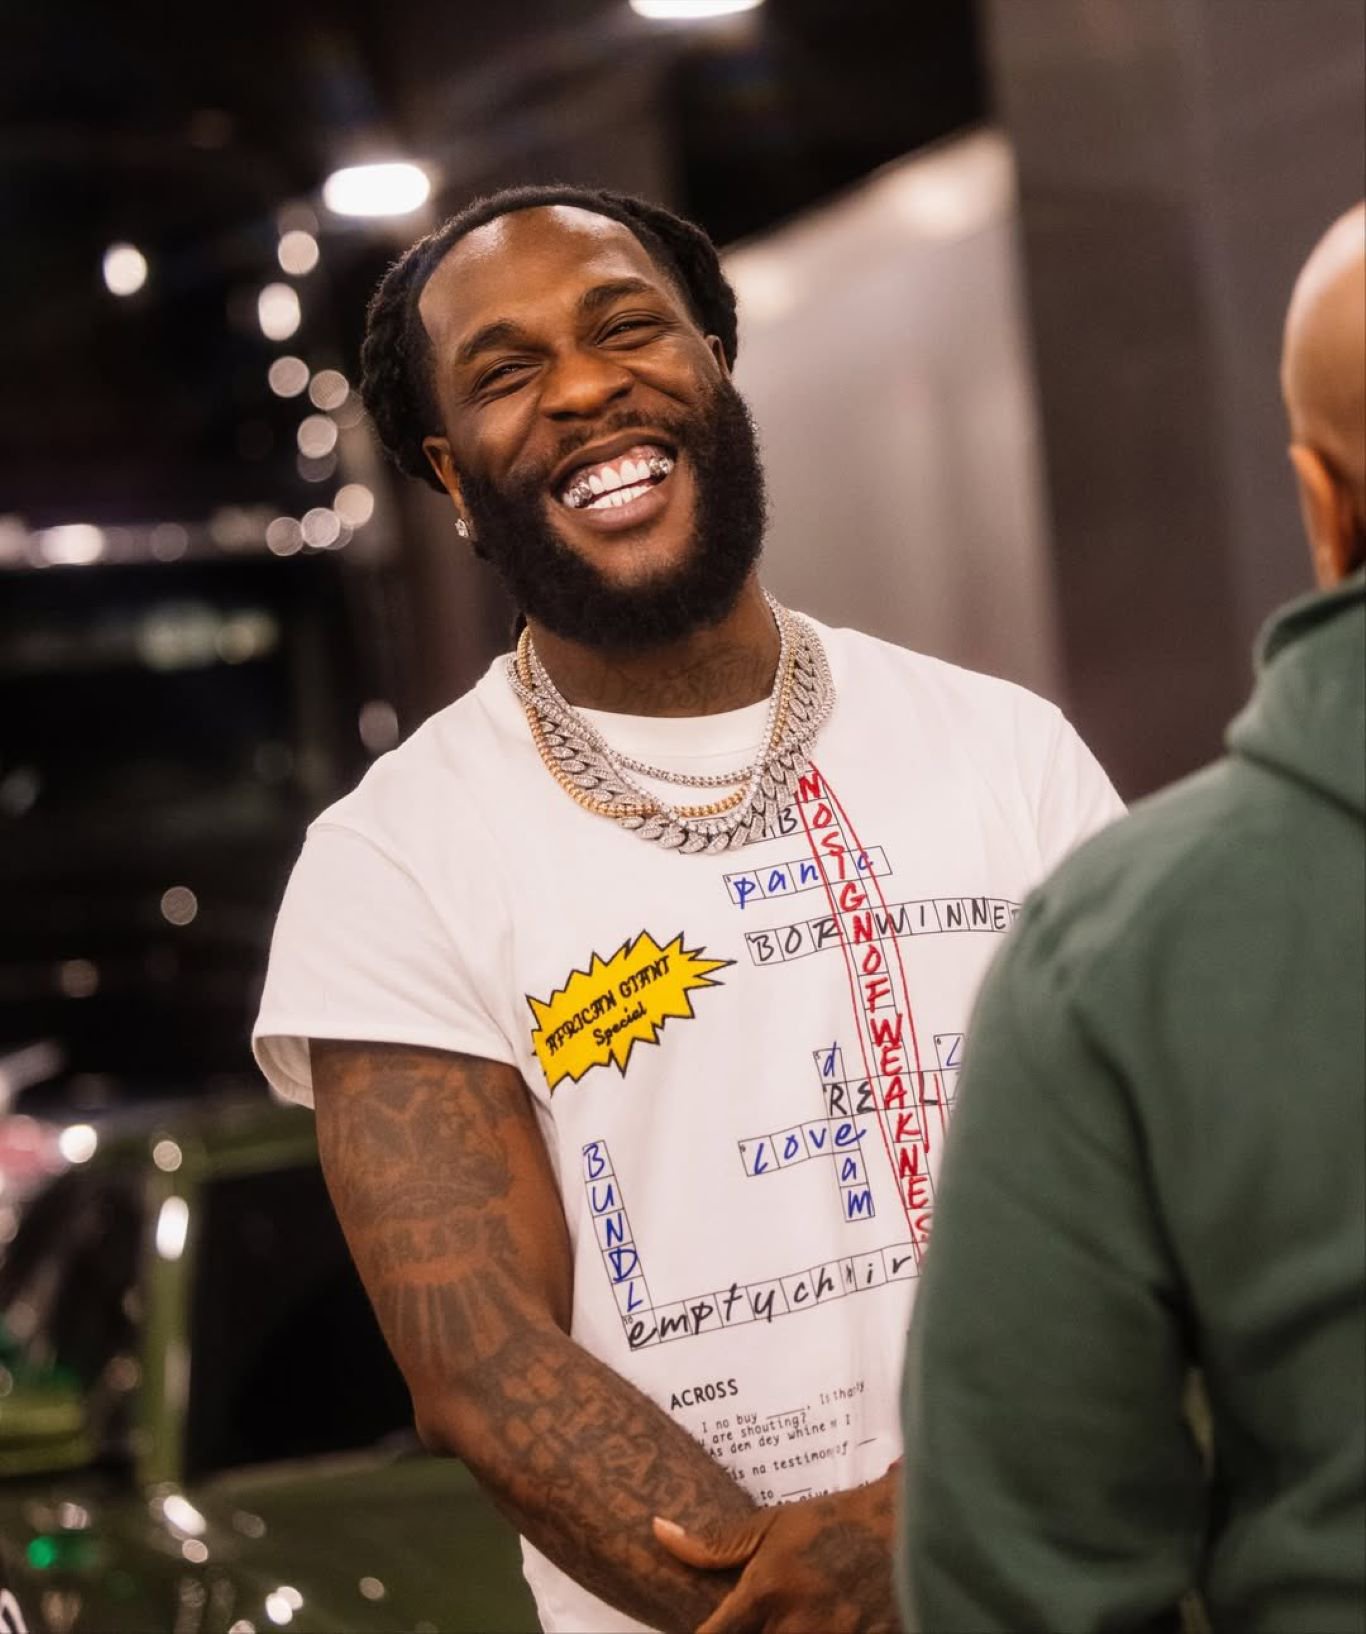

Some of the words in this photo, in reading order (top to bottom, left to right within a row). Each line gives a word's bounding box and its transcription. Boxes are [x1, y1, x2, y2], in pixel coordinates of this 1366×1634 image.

[545, 990, 617, 1056] AFRICAN
[618, 955, 669, 1000] GIANT
[592, 1001, 647, 1046] Special
[670, 1378, 738, 1411] ACROSS
[713, 1431, 733, 1444] are
[741, 1412, 807, 1438] shouting?
[736, 1413, 757, 1425] buy
[759, 1435, 780, 1447] dey
[773, 1447, 835, 1471] testimon
